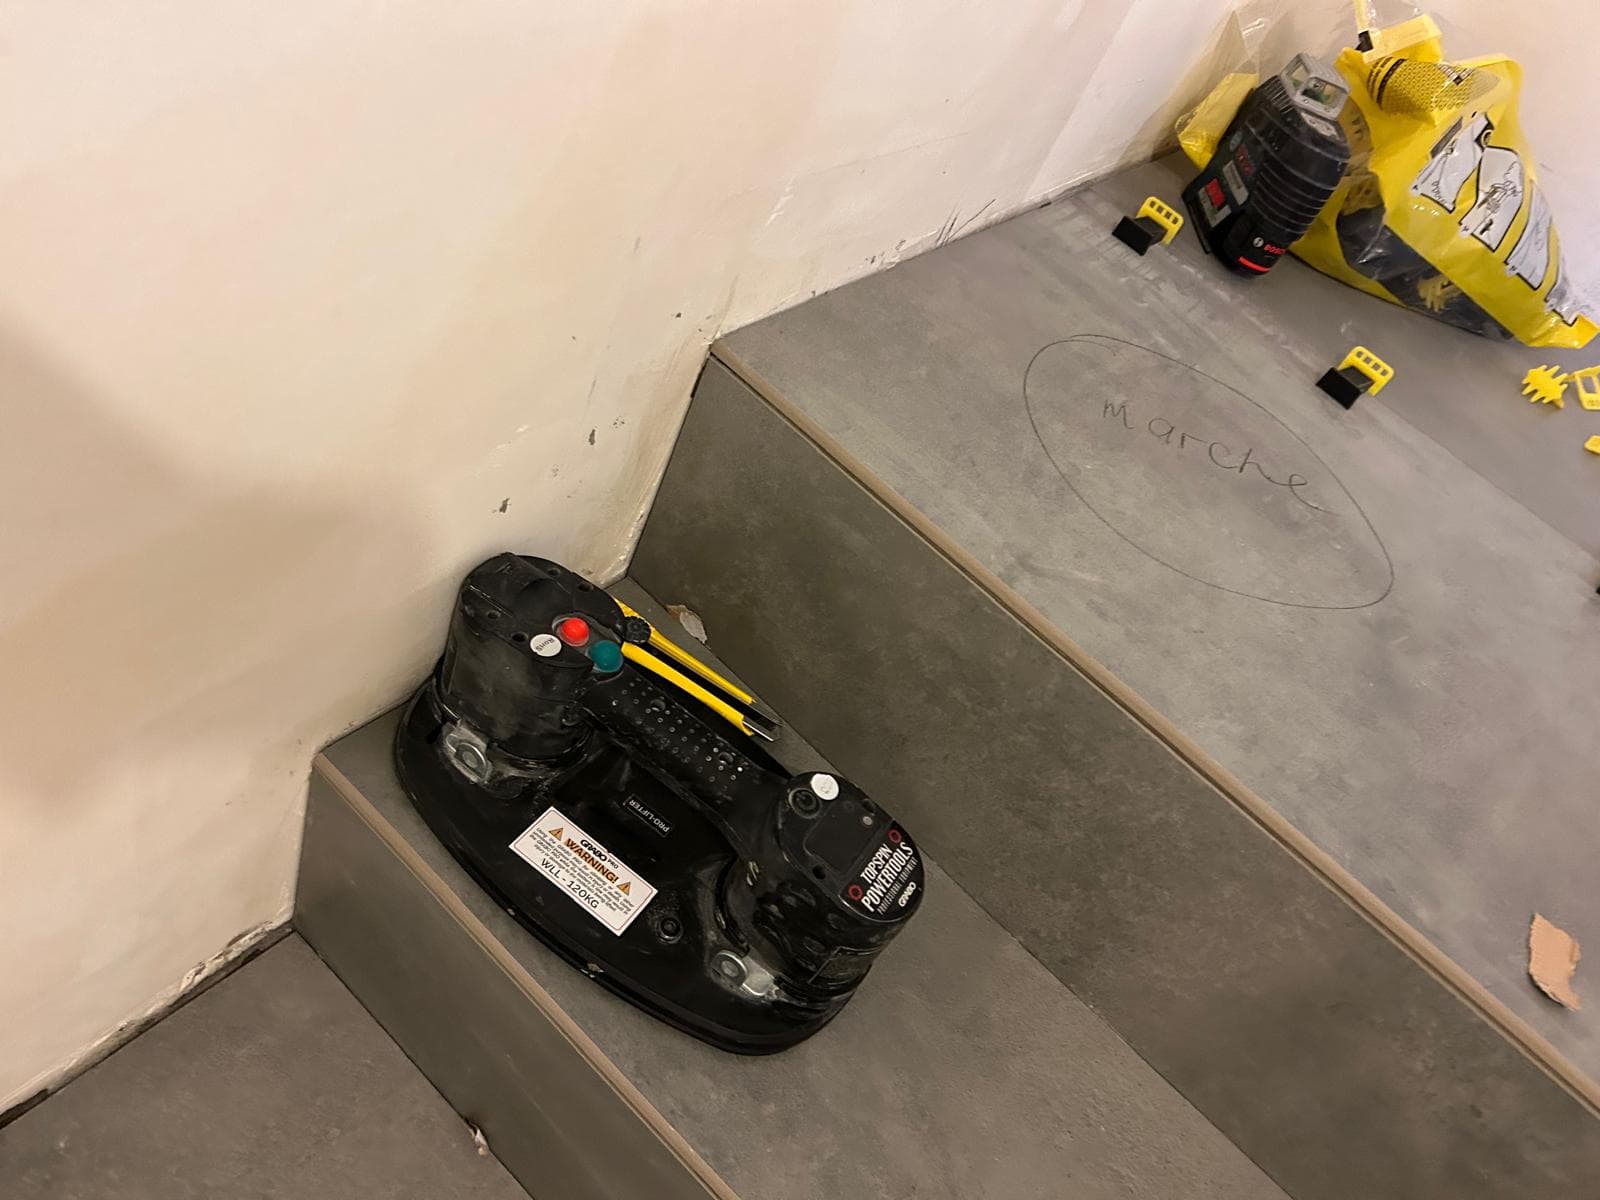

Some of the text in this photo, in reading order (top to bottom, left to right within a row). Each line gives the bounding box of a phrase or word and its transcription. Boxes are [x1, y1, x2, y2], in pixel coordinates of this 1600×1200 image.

[629, 800, 670, 832] PRO-LIFTER
[564, 838, 619, 884] WARNING!
[580, 839, 619, 869] GRABO PRO
[860, 843, 893, 884] TOPSPIN
[541, 858, 561, 878] WLL
[567, 880, 600, 909] 120KG
[861, 842, 913, 912] POWERTOOLS
